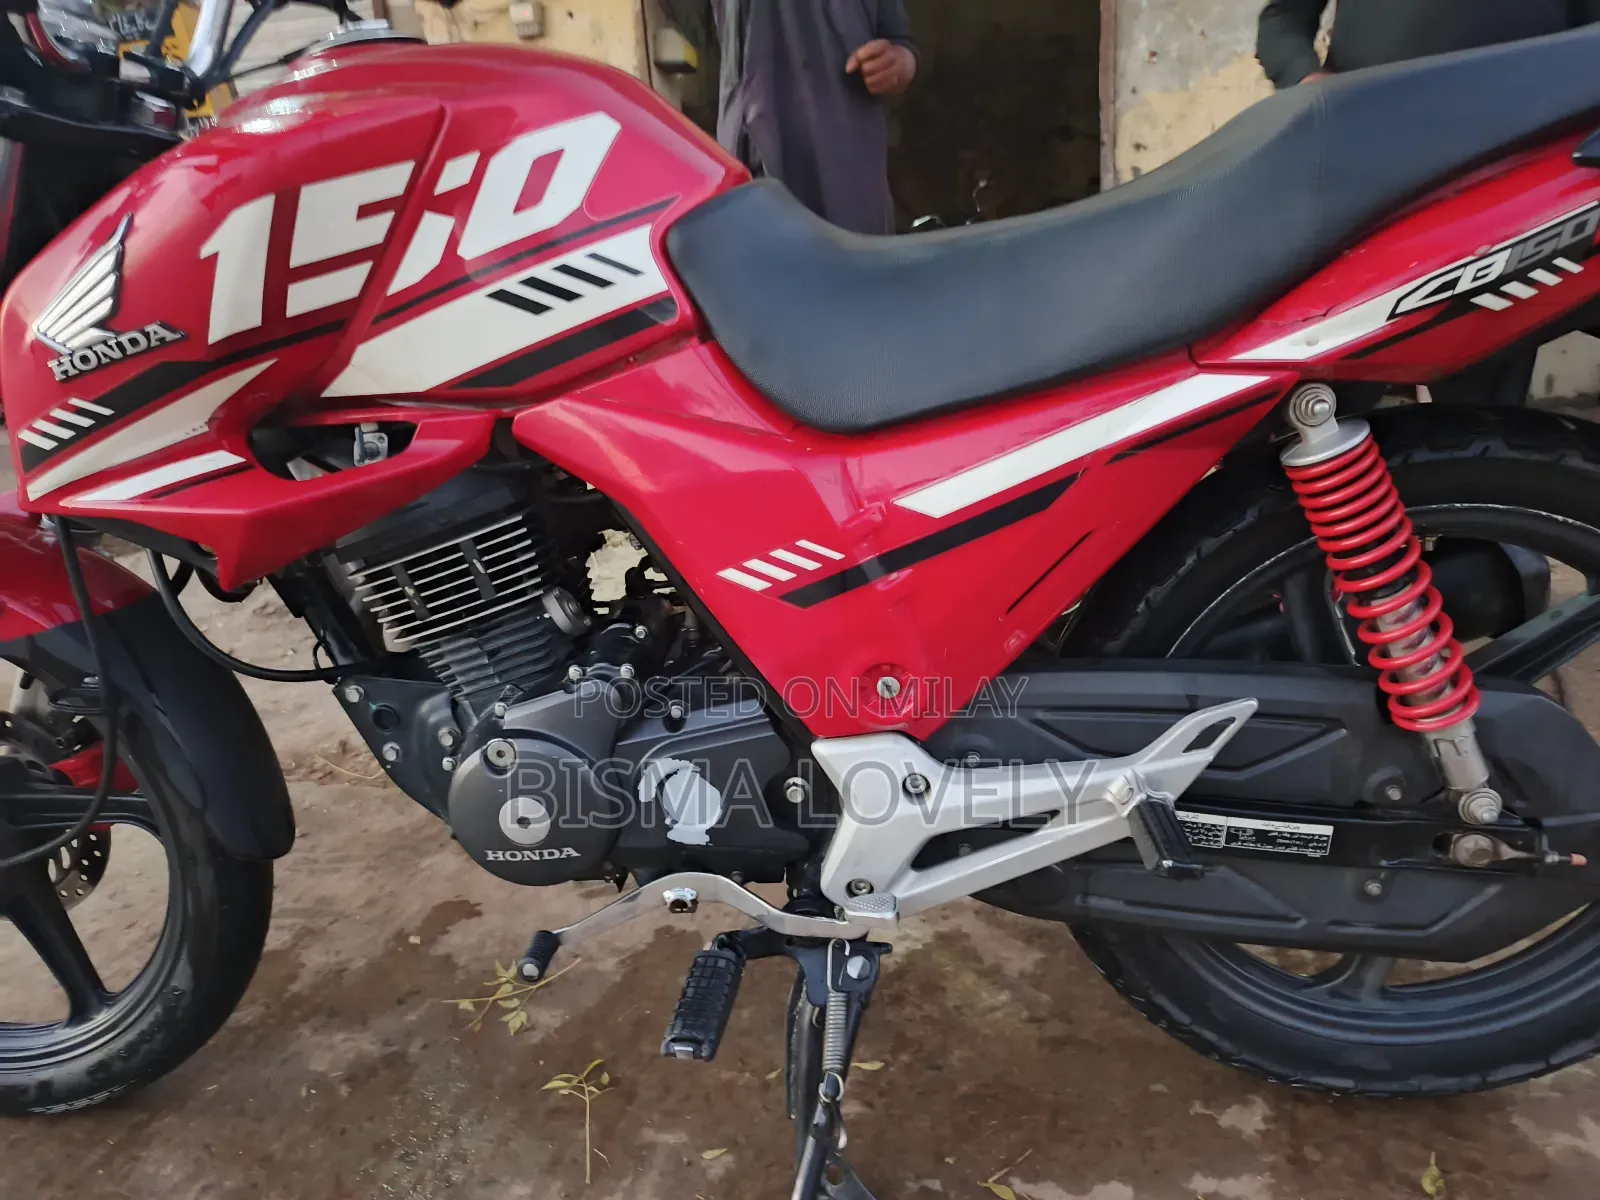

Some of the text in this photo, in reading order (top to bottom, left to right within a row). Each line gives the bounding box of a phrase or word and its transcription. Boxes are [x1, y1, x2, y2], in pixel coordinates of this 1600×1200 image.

[200, 111, 621, 345] 150
[47, 320, 185, 381] HONDA
[484, 847, 581, 862] HONDA
